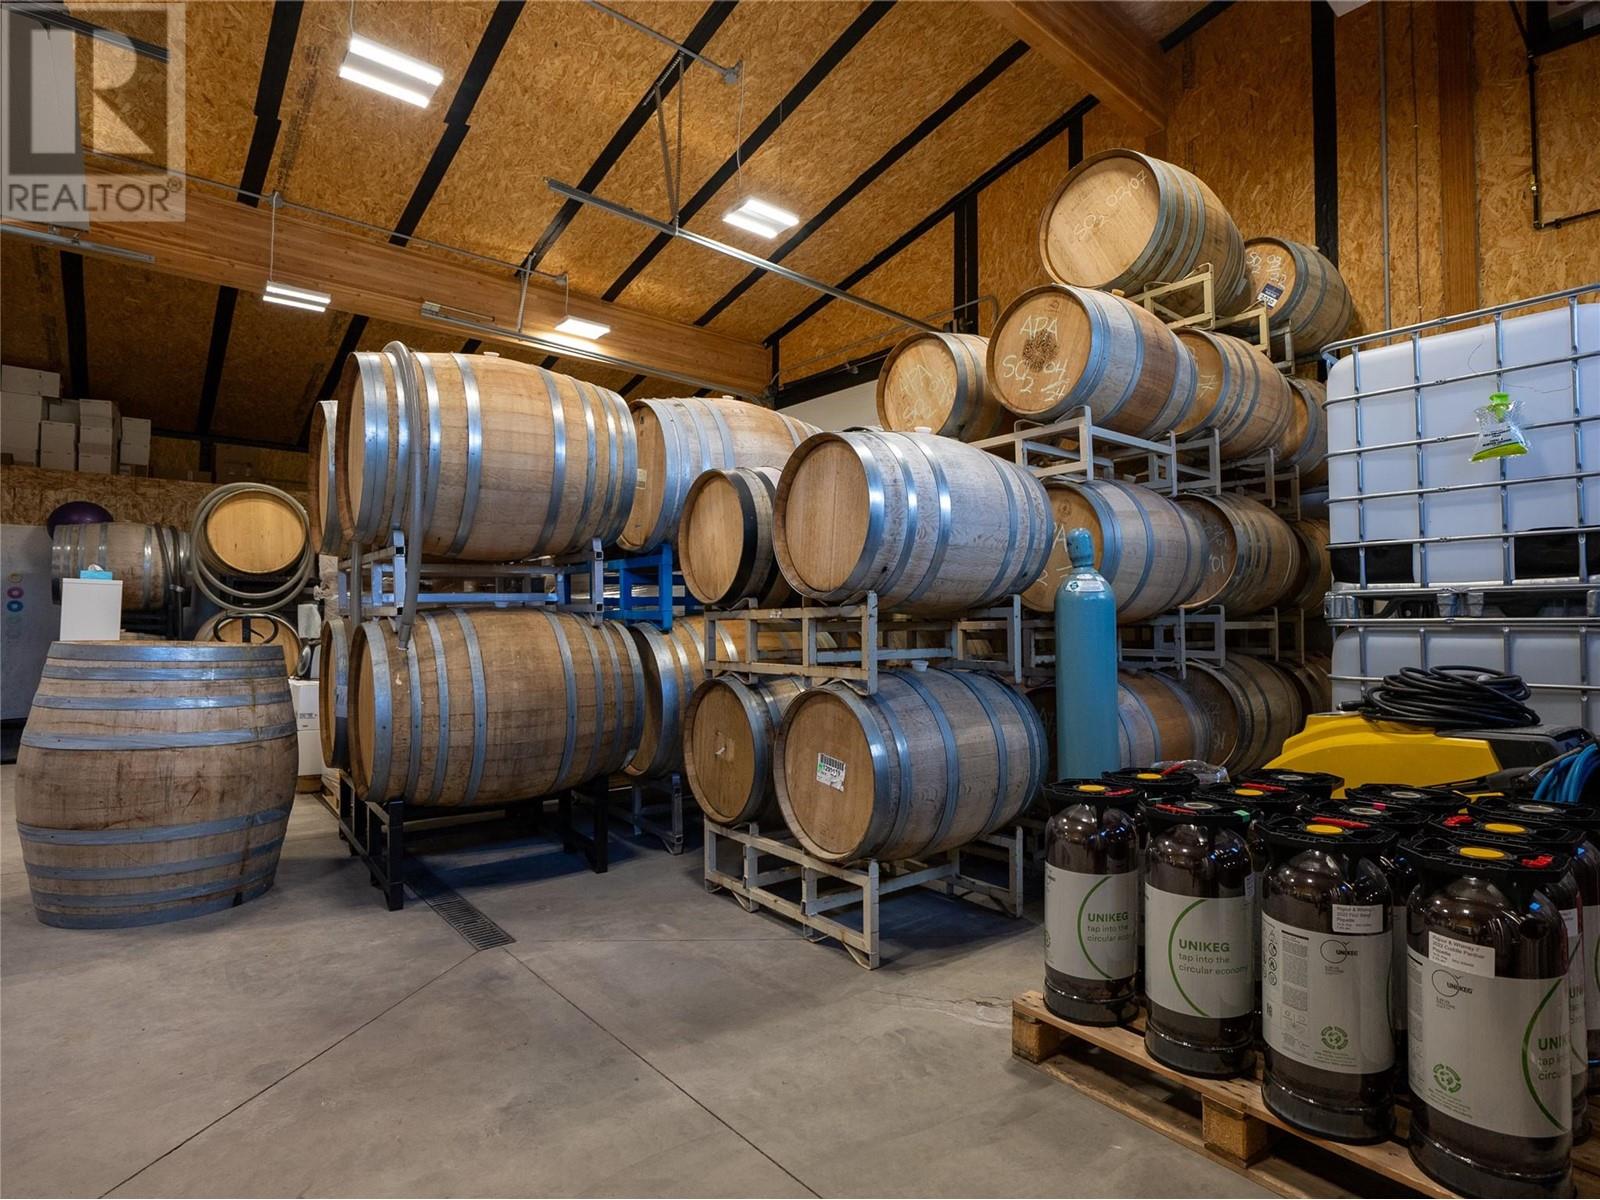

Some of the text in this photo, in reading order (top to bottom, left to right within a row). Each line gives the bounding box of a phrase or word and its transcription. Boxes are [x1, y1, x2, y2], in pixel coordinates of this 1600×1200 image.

[1019, 314, 1059, 342] APA
[1087, 911, 1129, 922] UNIKEG
[1087, 925, 1101, 933] tap
[1087, 935, 1117, 943] circular
[1178, 938, 1231, 953] UNIKEG
[1178, 952, 1230, 964] tap into the
[1178, 964, 1214, 975] circular
